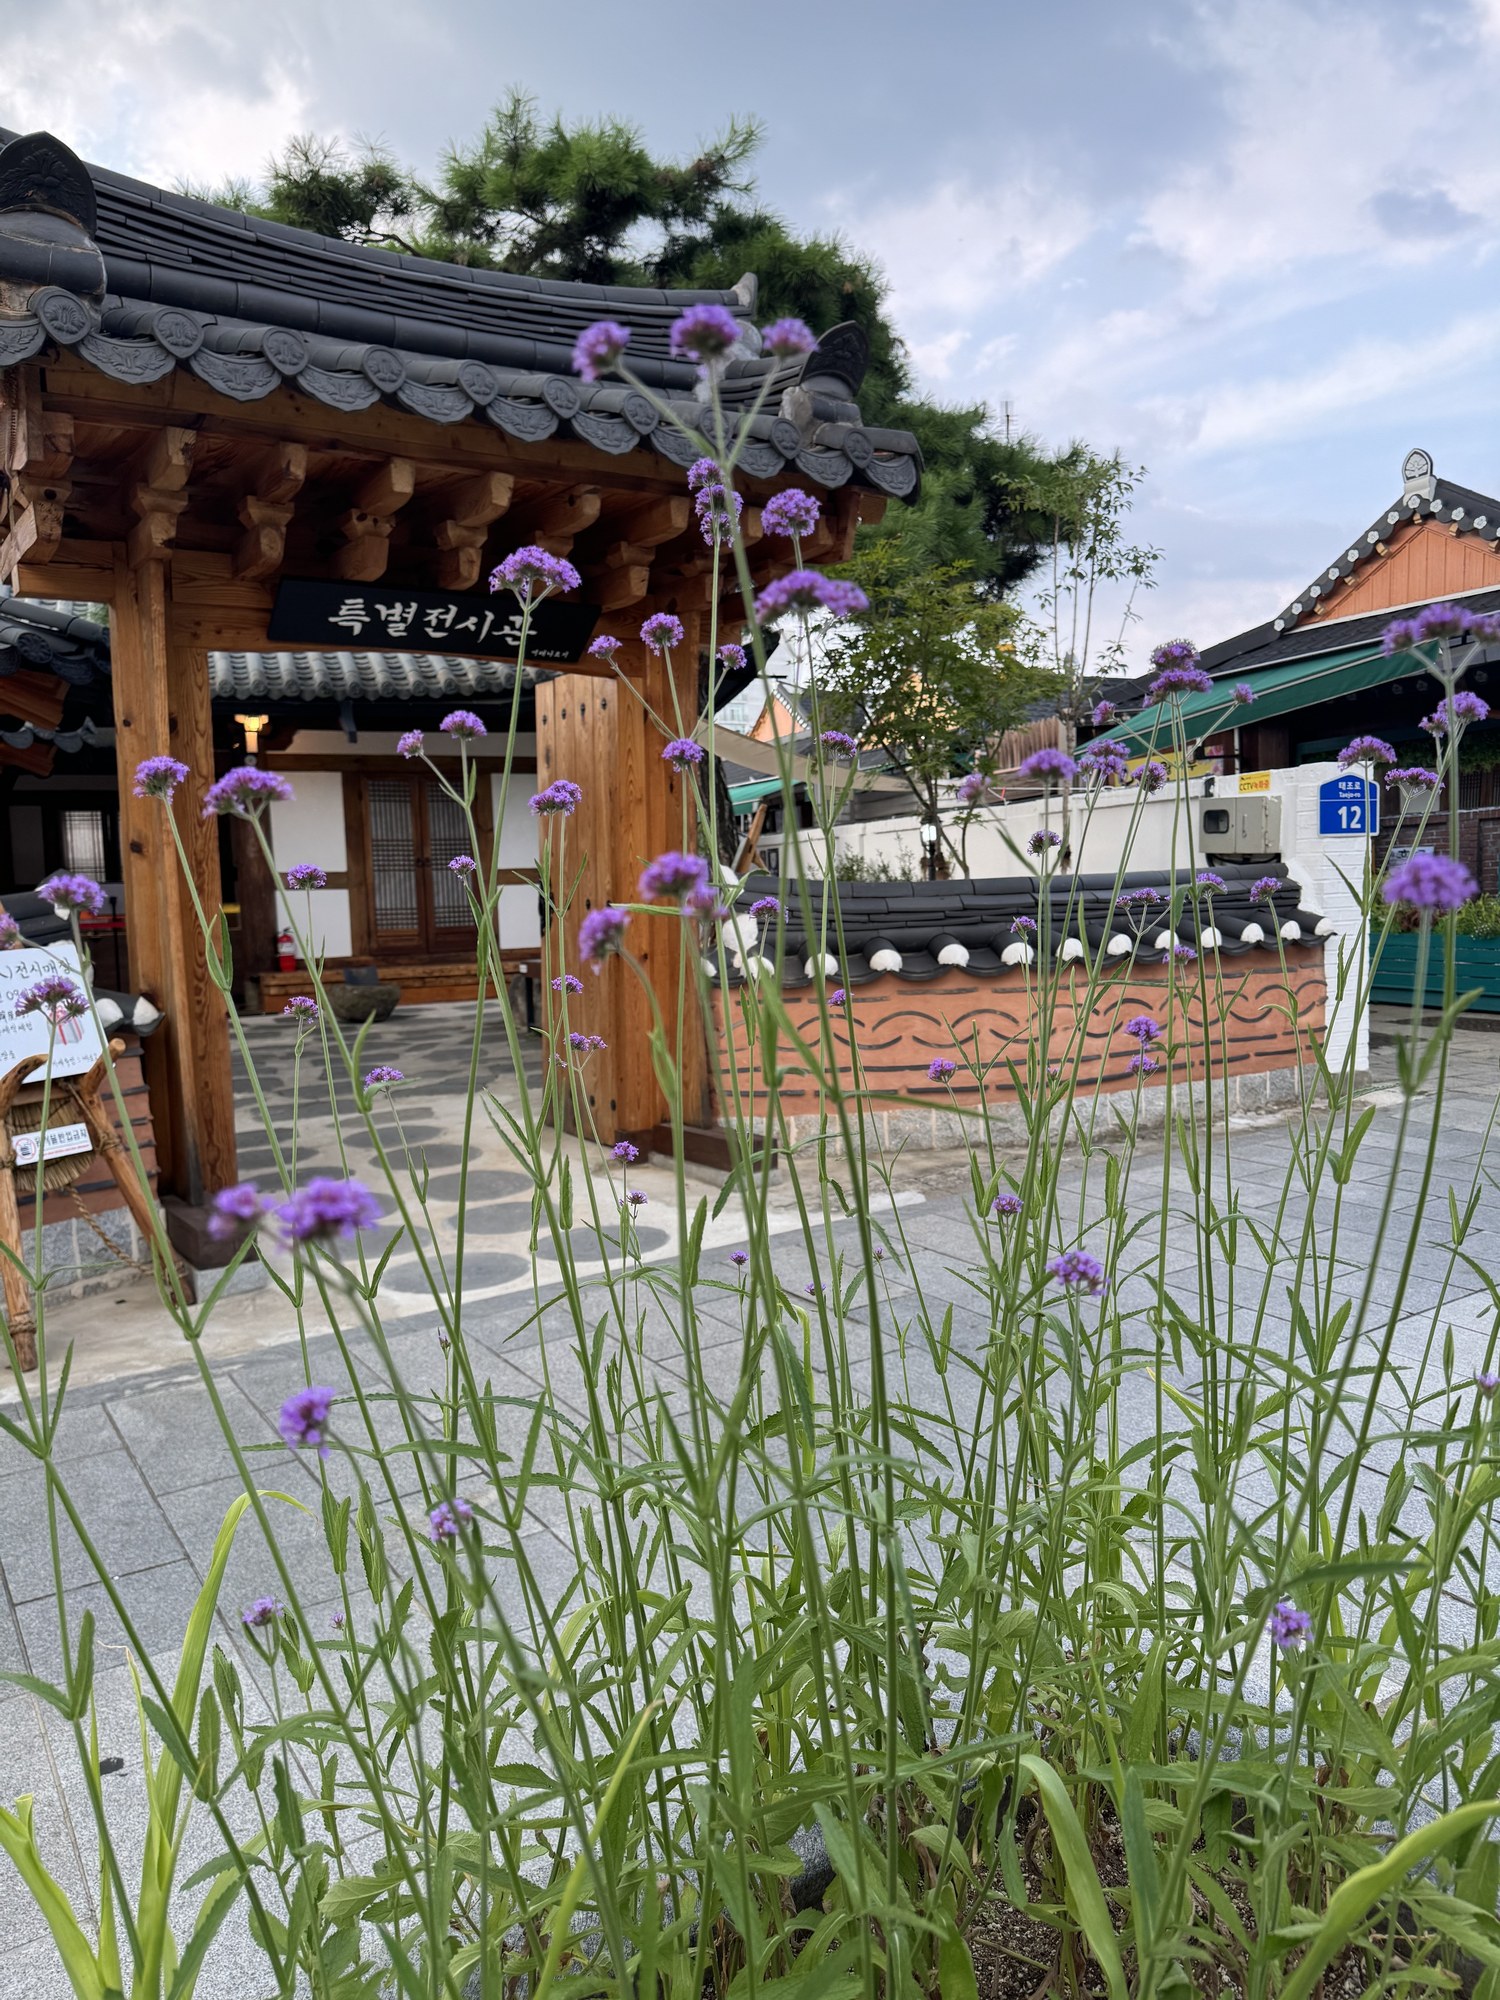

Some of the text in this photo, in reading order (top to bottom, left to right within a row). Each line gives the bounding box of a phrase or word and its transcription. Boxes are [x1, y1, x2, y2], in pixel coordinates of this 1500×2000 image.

[327, 598, 538, 646] 특별전시관
[1338, 781, 1362, 791] 태조로
[1337, 805, 1362, 829] 12
